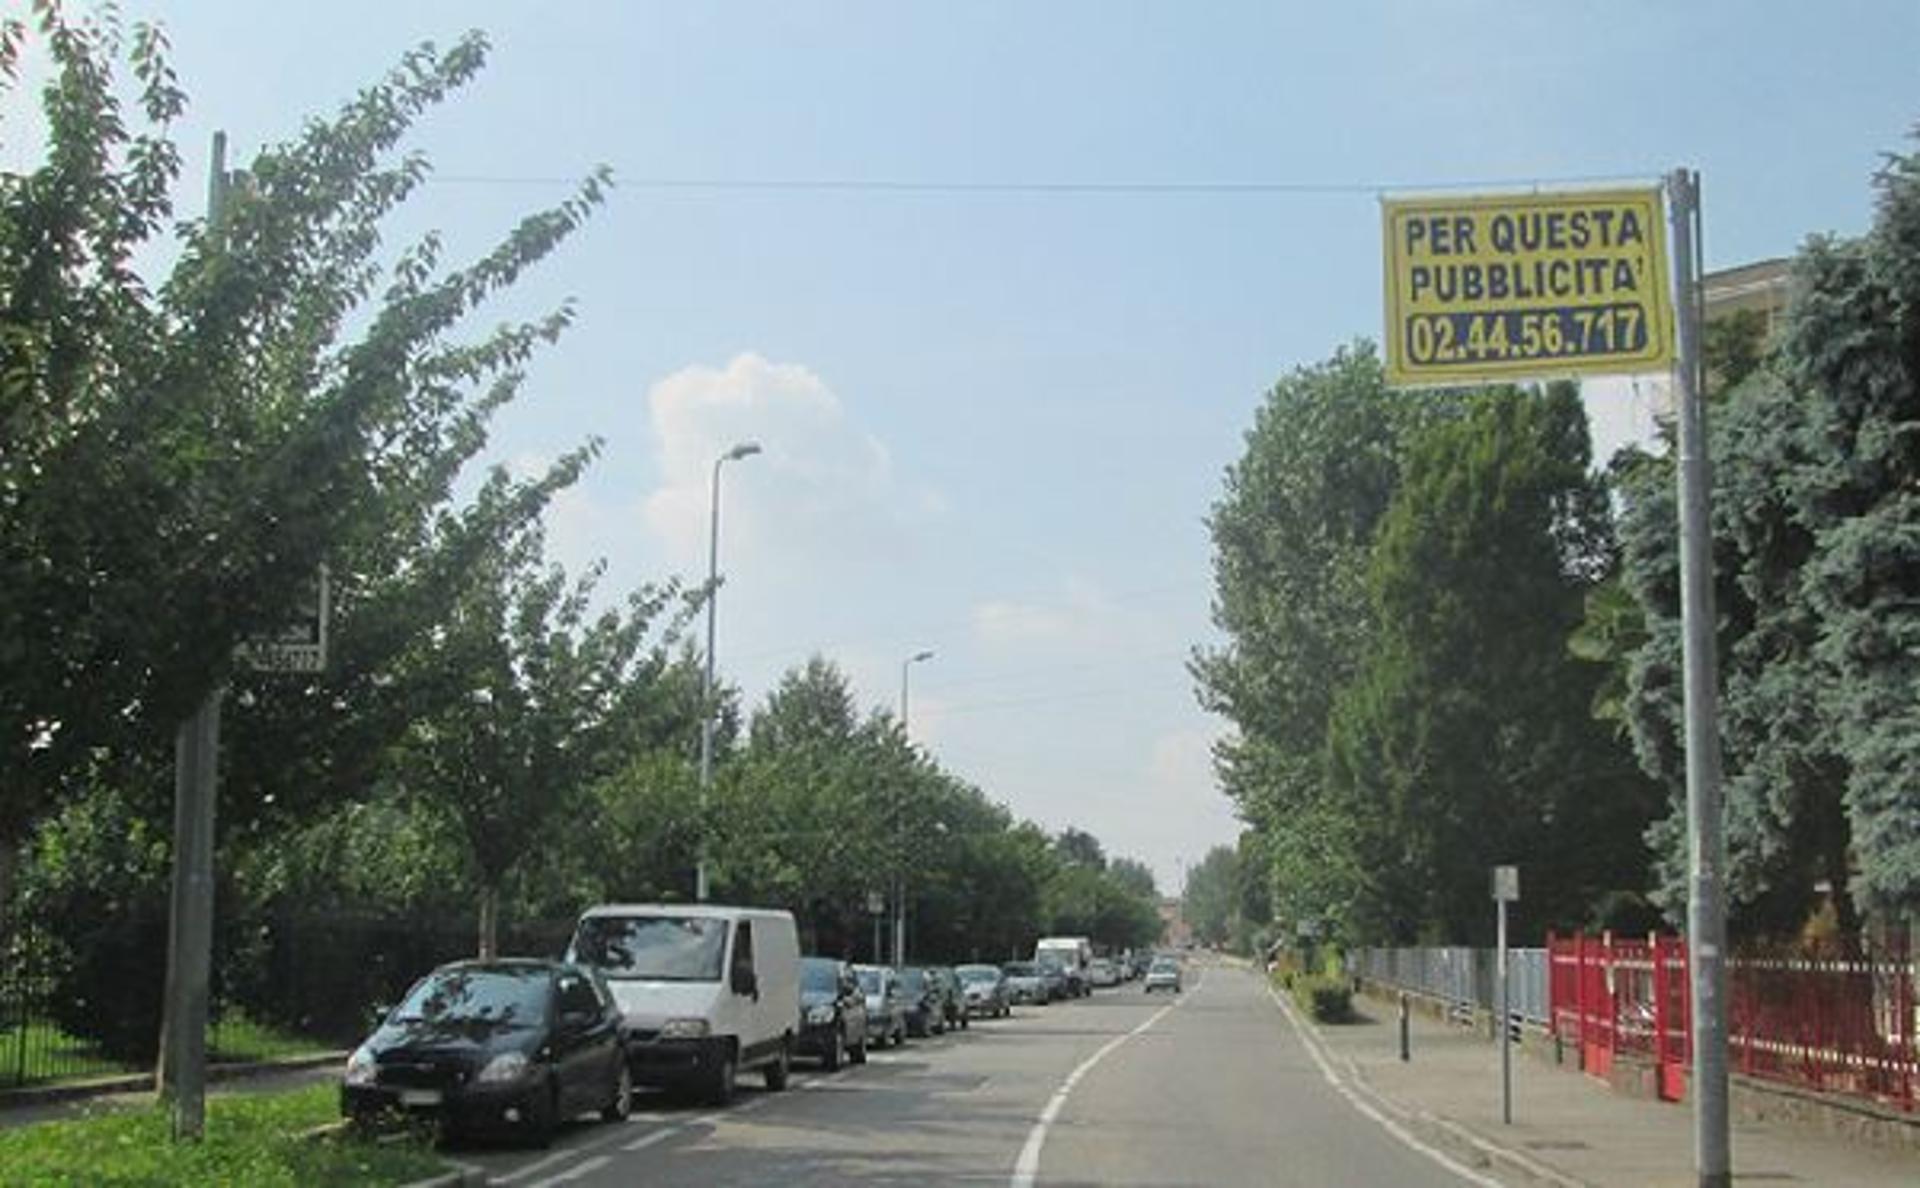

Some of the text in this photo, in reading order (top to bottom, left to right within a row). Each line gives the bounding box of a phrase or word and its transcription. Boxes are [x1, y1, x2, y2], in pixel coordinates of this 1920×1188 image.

[1406, 209, 1643, 256] PER QUESTA
[1411, 256, 1644, 302] PUBBLICITA'
[1412, 308, 1640, 363] 02.44.56.717
